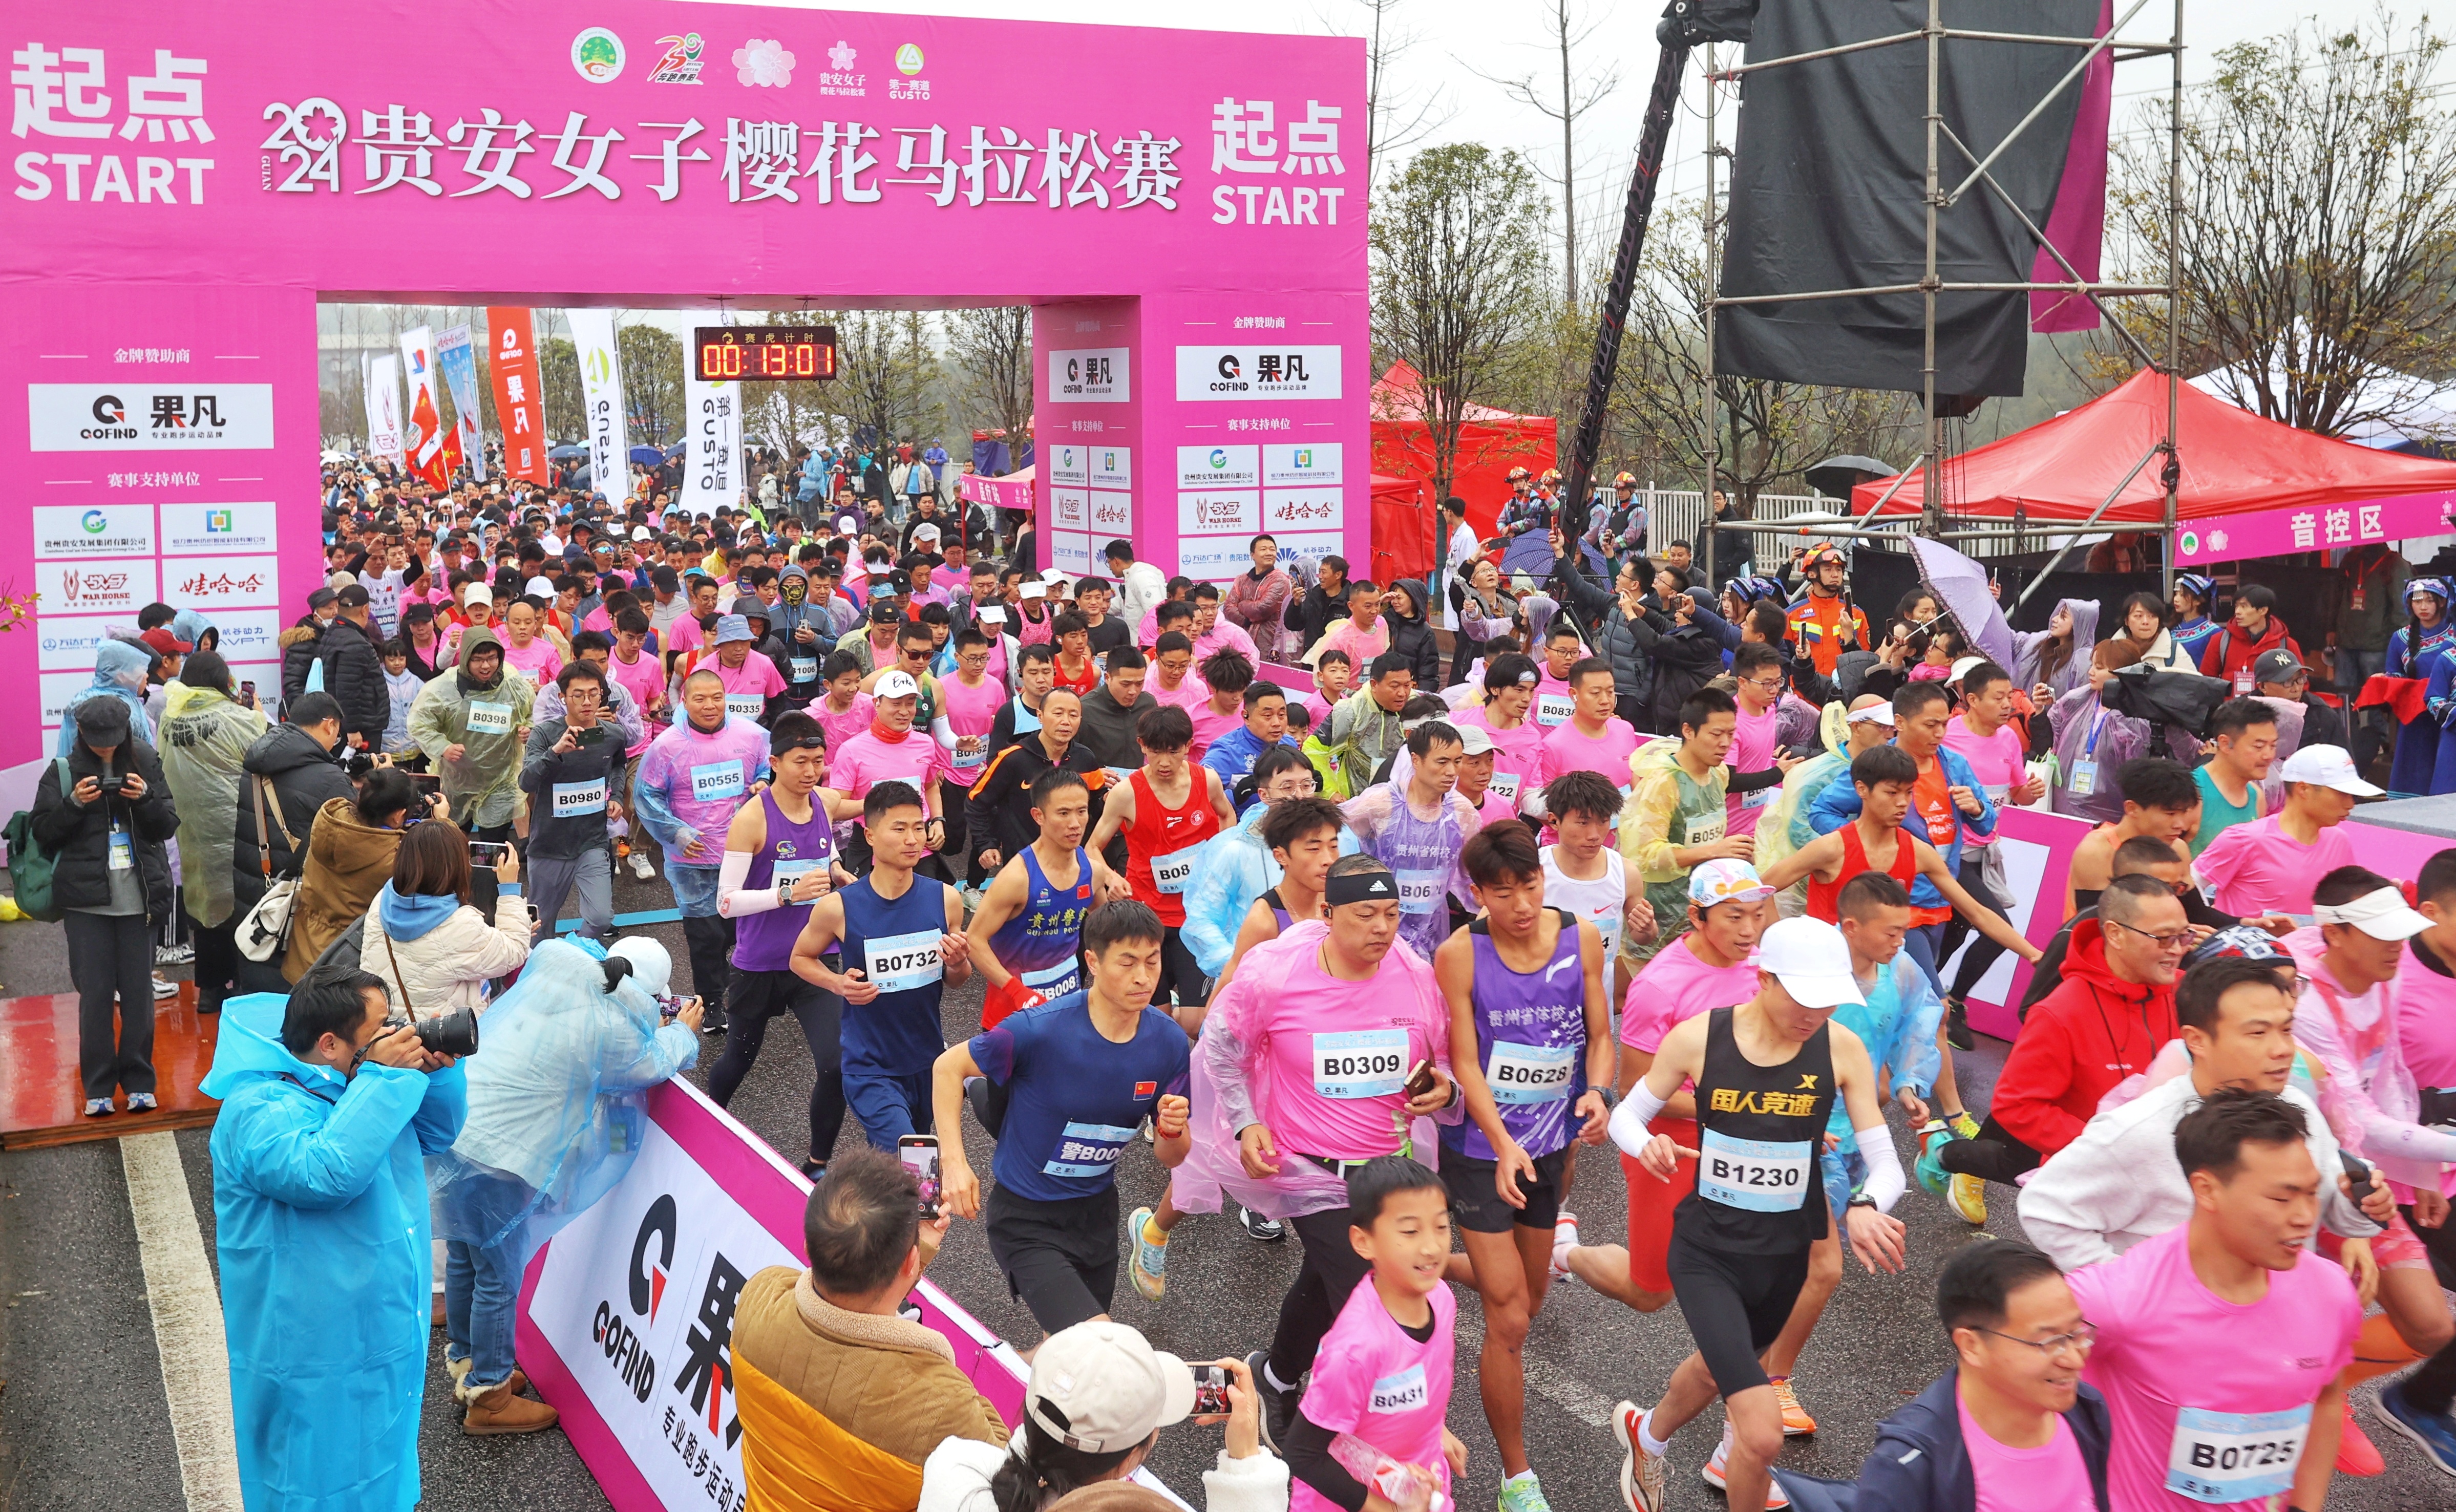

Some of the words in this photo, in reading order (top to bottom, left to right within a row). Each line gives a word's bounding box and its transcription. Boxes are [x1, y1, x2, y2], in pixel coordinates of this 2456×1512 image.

[657, 73, 696, 82] 奔跑贵阳
[819, 72, 866, 86] 贵安女子
[888, 79, 930, 91] 第一赛道
[11, 42, 216, 144] 起点
[820, 87, 865, 97] 樱花马拉松赛
[889, 91, 930, 100] GUSTO
[1211, 97, 1346, 176] 起点
[352, 104, 1182, 210] 贵安女子樱花马拉松赛
[14, 152, 215, 205] START
[261, 155, 271, 191] GUIAN
[1212, 185, 1345, 225] START
[1233, 316, 1285, 329] 金牌赞助商
[745, 332, 814, 344] 赛虎计时
[113, 348, 190, 364] 金牌赞助商
[703, 344, 832, 376] 00:13:01
[1086, 357, 1112, 385] 果凡
[1257, 354, 1309, 382] 果凡
[151, 395, 226, 428] 果凡
[1072, 420, 1103, 432] 赛事支持单位
[1227, 418, 1290, 431] 赛事支持单位
[152, 431, 223, 439] 专业跑步运动品牌
[703, 399, 715, 491] GUSTO
[714, 394, 730, 492] 第一赛道
[108, 472, 200, 488] 赛事支持单位
[1096, 503, 1126, 523] 娃哈哈
[1275, 501, 1332, 520] 娃哈哈
[2291, 505, 2384, 548] 音控区
[1229, 553, 1253, 562] 贵阳数
[179, 572, 264, 595] 娃哈哈
[2275, 653, 2291, 666] NY
[474, 713, 506, 724] B0398
[729, 705, 760, 713] B0335
[698, 773, 739, 789] B0555
[1487, 785, 1513, 797] 122
[559, 791, 601, 805] B0980
[1396, 844, 1451, 858] 贵州省体校
[876, 950, 937, 973] B0732
[1488, 1005, 1566, 1027] 贵州省体校
[1324, 1055, 1400, 1075] B0309
[1498, 1064, 1568, 1084] B0628
[1710, 1088, 1821, 1117] 国人竞速
[1060, 1141, 1122, 1161] 警B00
[1712, 1158, 1799, 1186] B1230
[2189, 1438, 2298, 1470] B0725
